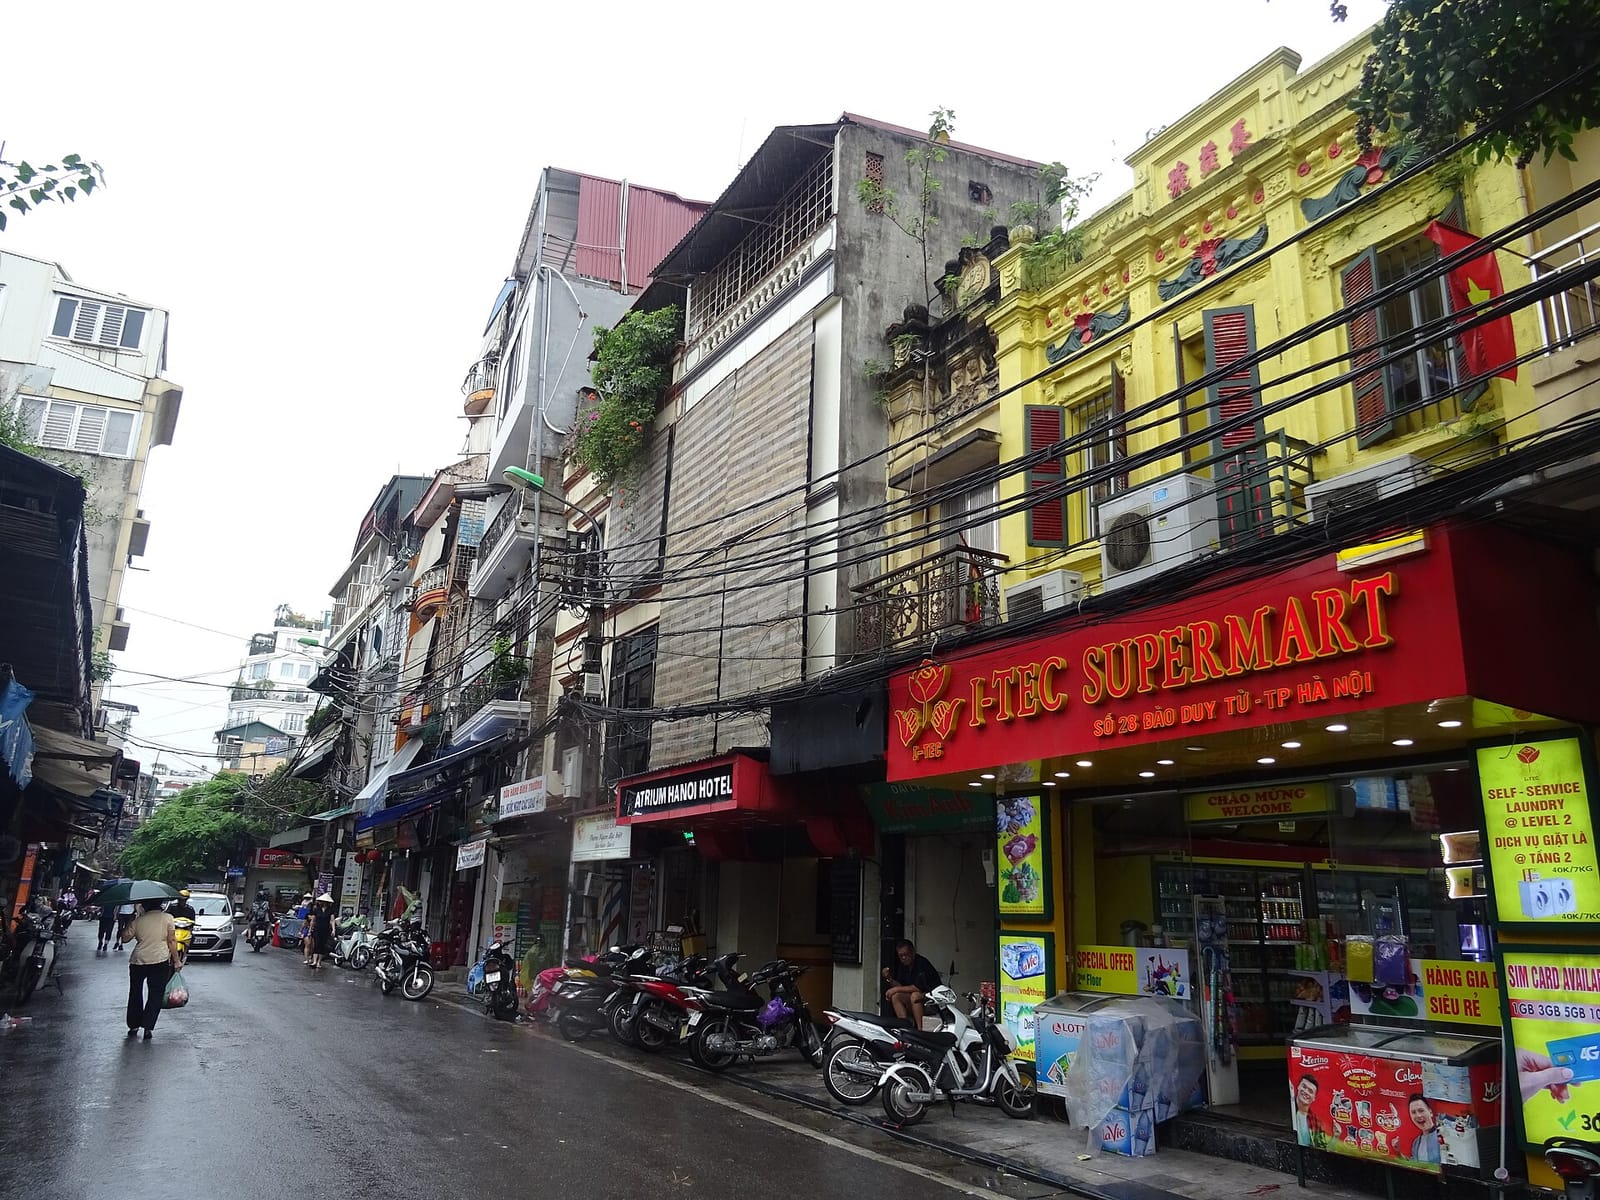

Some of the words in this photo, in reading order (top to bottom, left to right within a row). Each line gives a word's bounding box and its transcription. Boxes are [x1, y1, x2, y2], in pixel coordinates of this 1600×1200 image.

[969, 656, 1068, 727] I-TEC
[1082, 571, 1396, 705] SUPERMART
[1094, 712, 1114, 737] SỐ
[1118, 715, 1137, 734] 28
[1143, 705, 1175, 729] ĐÀO
[1181, 700, 1216, 724] DUY
[1298, 676, 1327, 704] HÀ
[1333, 671, 1374, 698] NỘI
[634, 786, 667, 809] ATRIUM
[668, 781, 697, 804] HANOI
[699, 775, 732, 799] HOTEL
[1208, 792, 1250, 806] CHÀO
[1488, 787, 1517, 800] SELF
[1526, 782, 1581, 797] SERVICE
[1221, 802, 1292, 816] WELCOME
[1506, 799, 1564, 813] LAUNDRY
[1522, 816, 1559, 828] LEVEL
[1564, 814, 1572, 825] 2
[1495, 837, 1521, 850] DỊCH
[1524, 836, 1539, 849] VỤ
[1573, 831, 1588, 845] LÀ
[1565, 852, 1572, 863] 2
[1077, 951, 1108, 970] SPECIAL
[1110, 952, 1134, 972] OFFER
[1086, 973, 1102, 986] Floor
[1426, 965, 1461, 987] HÀNG
[1466, 970, 1489, 988] GIA
[1508, 965, 1529, 988] SIM
[1531, 966, 1560, 990] CARD
[1430, 994, 1459, 1015] SIÊU
[1463, 992, 1481, 1017] RẺ
[1512, 1003, 1535, 1015] 1GB
[1538, 1004, 1561, 1017] 3GB
[1565, 1006, 1586, 1019] 5GB
[1302, 1054, 1328, 1065] Merino
